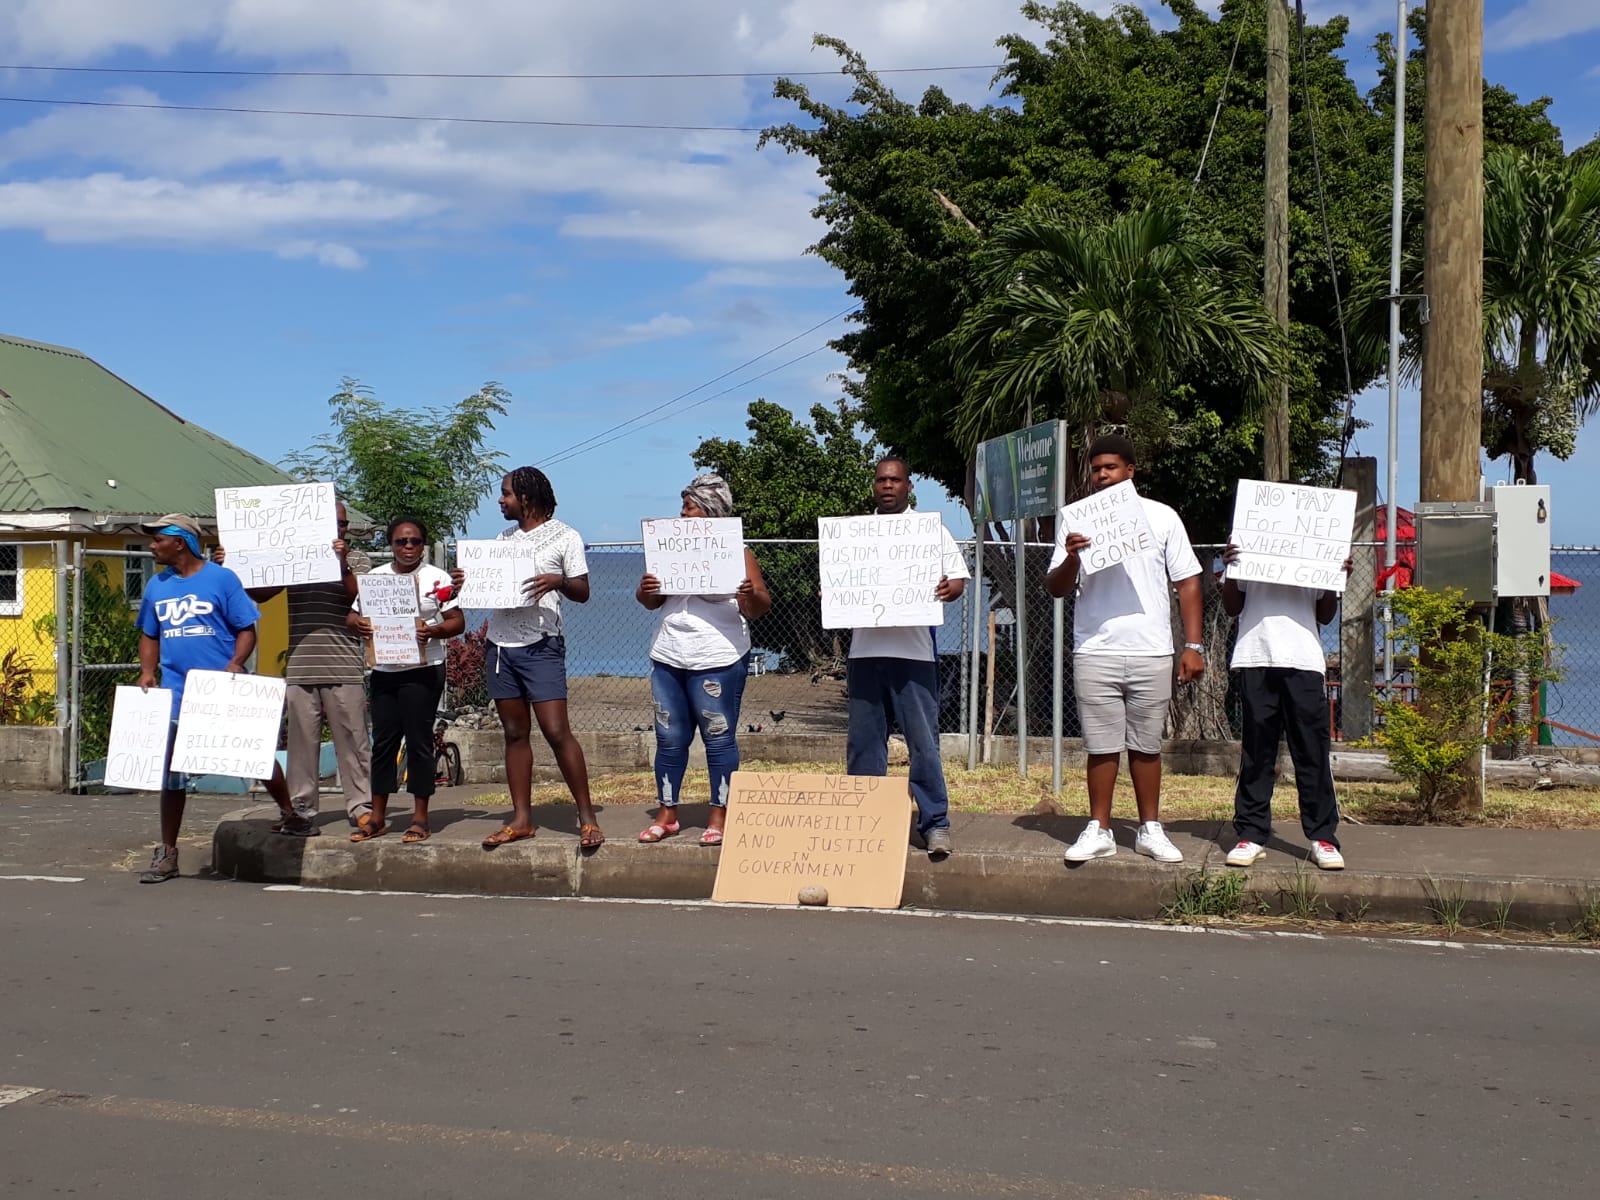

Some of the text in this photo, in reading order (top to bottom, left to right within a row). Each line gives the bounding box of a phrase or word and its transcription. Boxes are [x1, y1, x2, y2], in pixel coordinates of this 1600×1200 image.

[1017, 432, 1053, 463] Welcome
[224, 485, 328, 510] Five STAR
[1069, 487, 1129, 521] WHERE
[1255, 485, 1336, 512] NO PAY
[234, 504, 325, 529] HOSPITAL
[1091, 510, 1119, 530] THE
[1295, 515, 1341, 538] NEP
[257, 527, 297, 547] FOR
[646, 519, 713, 536] 5 STAR
[821, 517, 940, 539] NO SHELTER FOR
[1091, 518, 1138, 548] ONEY
[464, 546, 482, 559] NO
[658, 536, 728, 552] HOSPITAL
[821, 544, 942, 564] CUSTOM OFFICERS
[1090, 532, 1151, 569] GONE
[1239, 534, 1345, 561] WHERE THE
[238, 544, 331, 565] 5 STAR
[713, 551, 733, 560] FOR
[250, 562, 320, 586] HOTEL
[463, 567, 503, 578] SHELTER
[651, 560, 711, 575] 5 STAR
[826, 563, 939, 587] WHERE THE
[1294, 566, 1345, 586] GONE
[463, 581, 504, 593] WHERE
[663, 575, 719, 590] HOTEL
[829, 589, 878, 606] MONEY
[872, 603, 886, 626] ?
[188, 675, 285, 702] NO TOWN
[128, 710, 160, 726] THE
[227, 704, 278, 720] BUILDING
[111, 730, 166, 749] MONEY
[186, 734, 264, 751] BILLIONS
[180, 755, 268, 775] MISSING
[757, 774, 880, 791] WE NEED
[737, 791, 866, 808] TRANSPARENCY
[735, 811, 882, 833] ACCOUNTABILITY
[737, 833, 886, 853] AND JUSTICE
[792, 851, 810, 861] IN
[738, 859, 857, 877] GOVERNMENT
